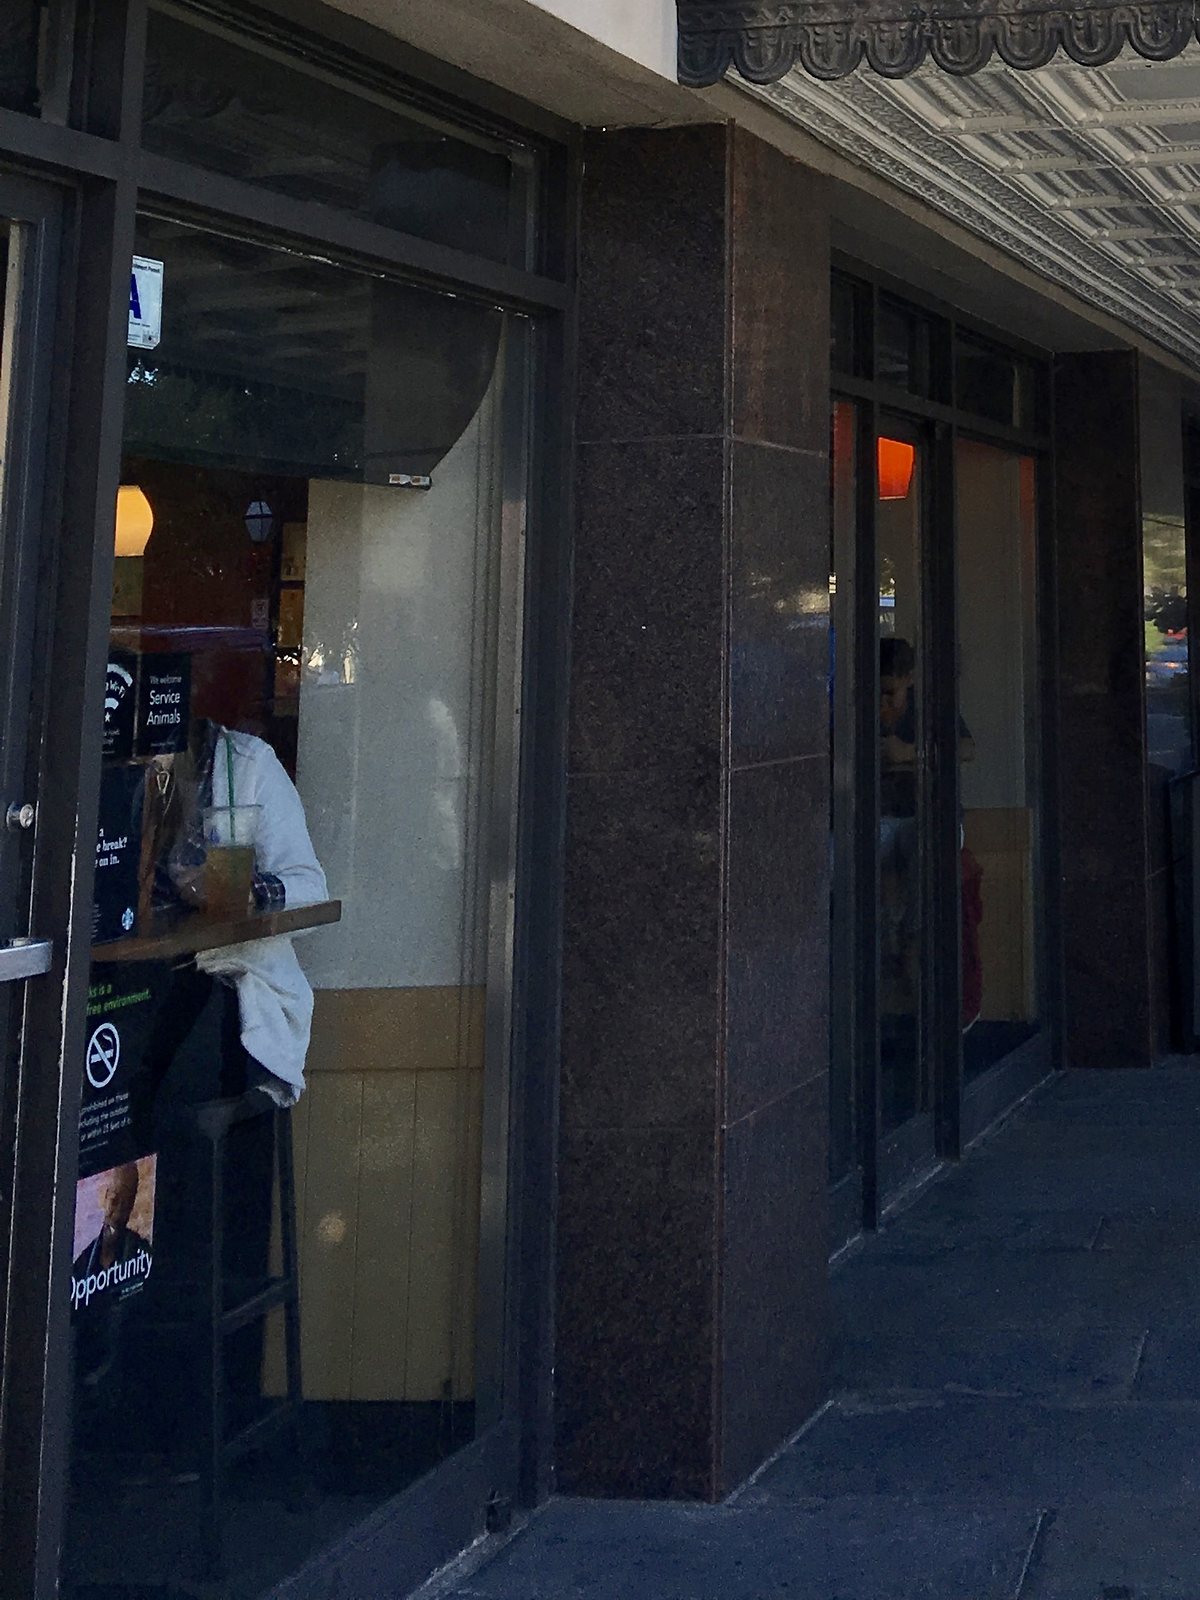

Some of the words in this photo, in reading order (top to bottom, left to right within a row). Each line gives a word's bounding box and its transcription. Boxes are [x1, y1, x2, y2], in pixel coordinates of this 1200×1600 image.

[149, 689, 181, 705] Service
[146, 708, 181, 726] Animals
[98, 827, 104, 837] a
[102, 836, 128, 852] break?
